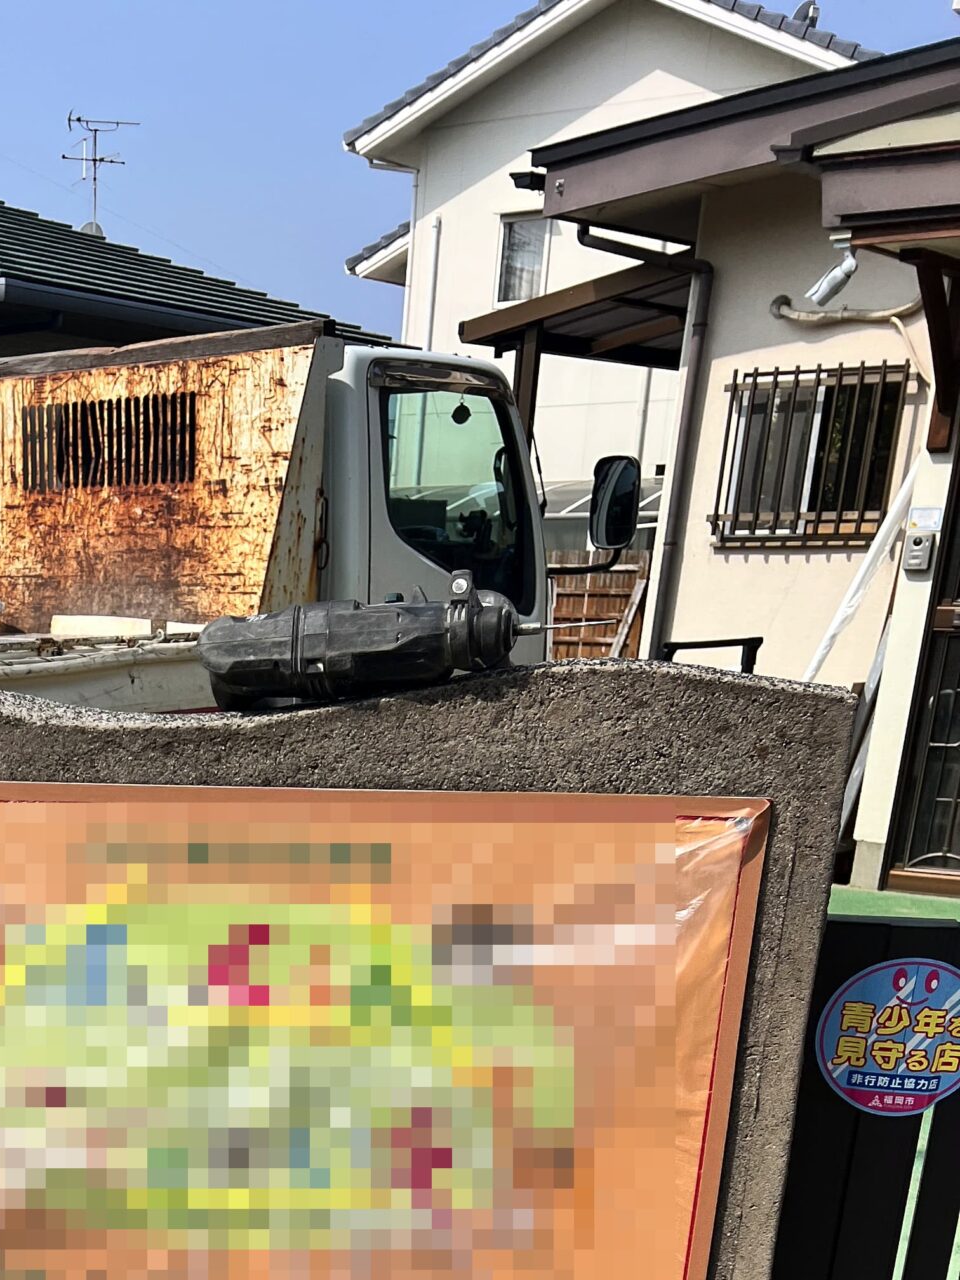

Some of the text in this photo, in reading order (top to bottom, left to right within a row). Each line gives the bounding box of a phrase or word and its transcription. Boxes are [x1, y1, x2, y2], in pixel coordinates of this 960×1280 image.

[832, 1036, 960, 1072] 見守る店
[851, 1074, 938, 1089] 非行防止協力店
[883, 1095, 915, 1105] 福岡市
